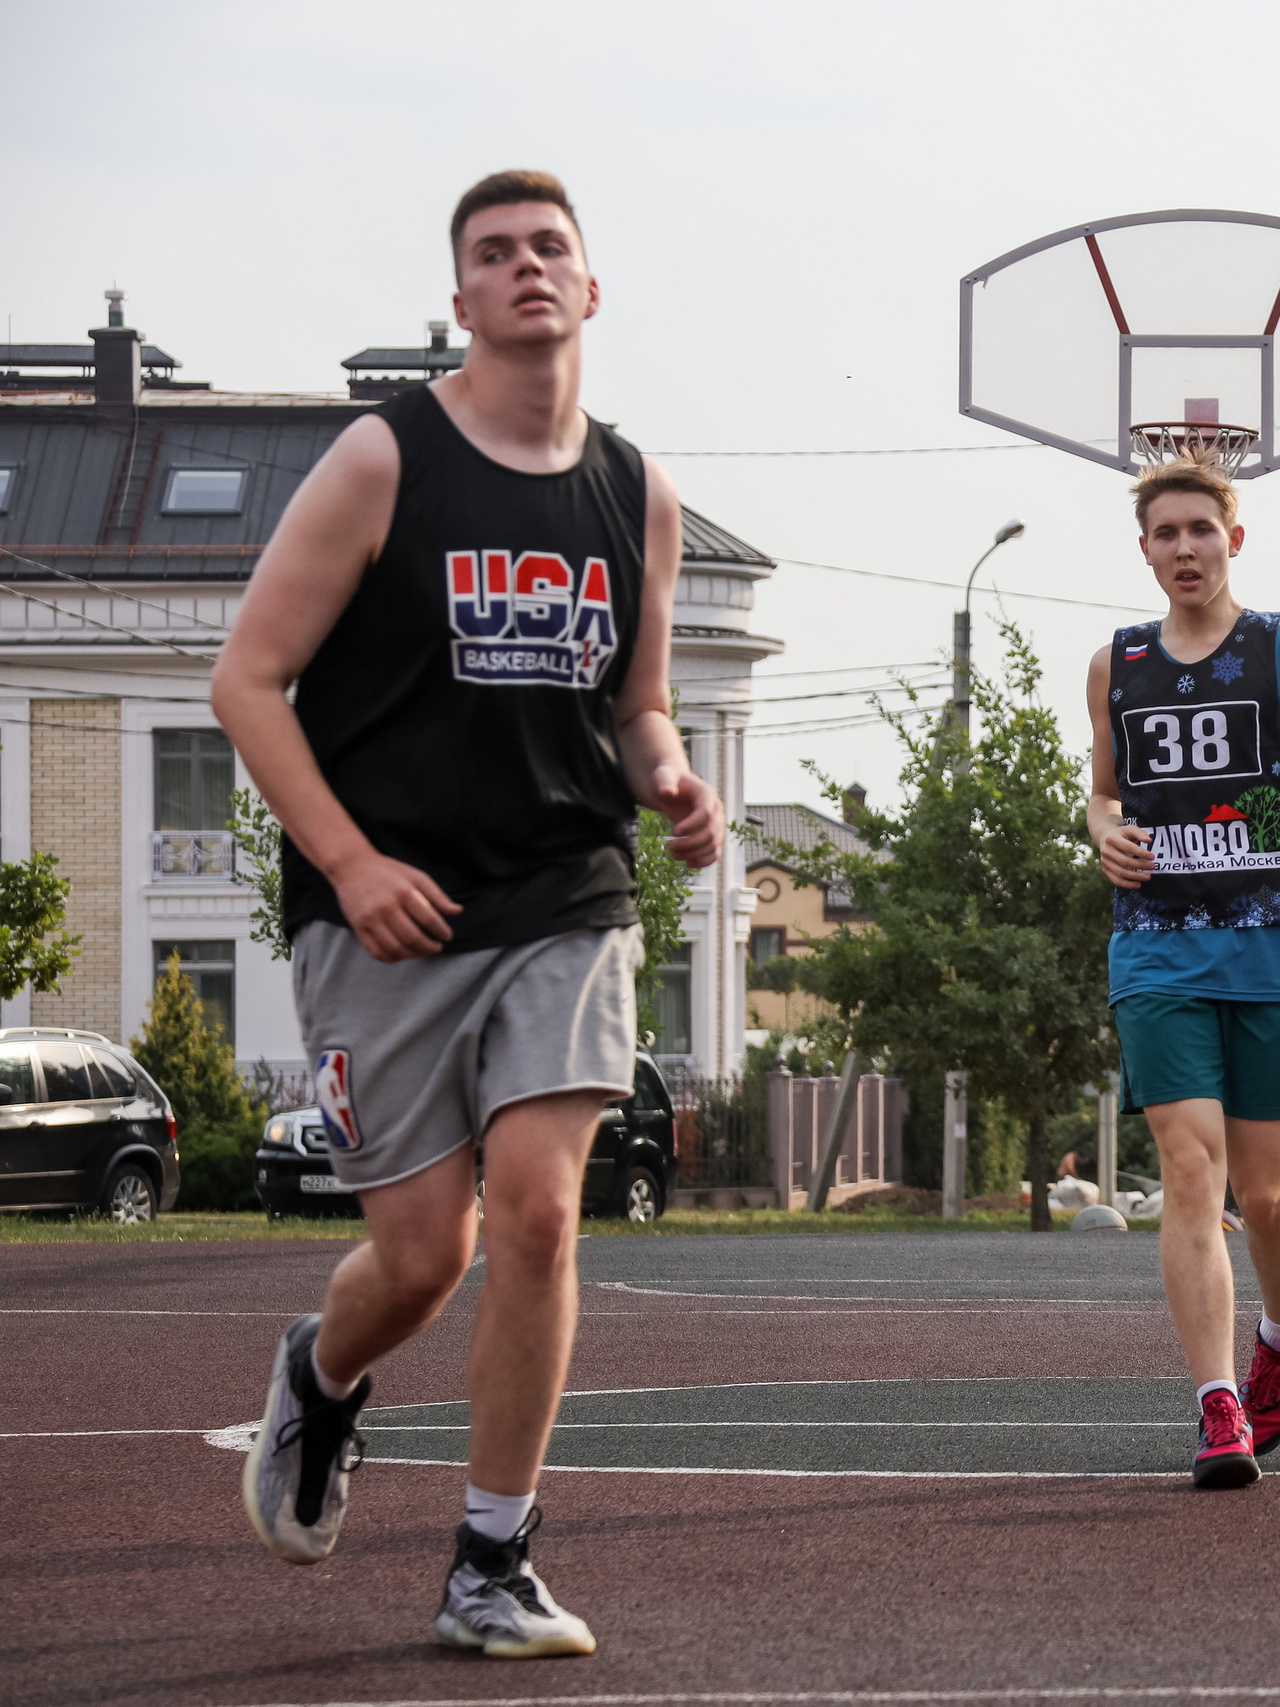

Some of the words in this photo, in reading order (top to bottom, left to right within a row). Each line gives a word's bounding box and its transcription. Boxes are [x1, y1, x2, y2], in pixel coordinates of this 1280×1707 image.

[446, 549, 618, 647] USA
[1143, 709, 1231, 773] 38
[1153, 860, 1225, 871] аленькая
